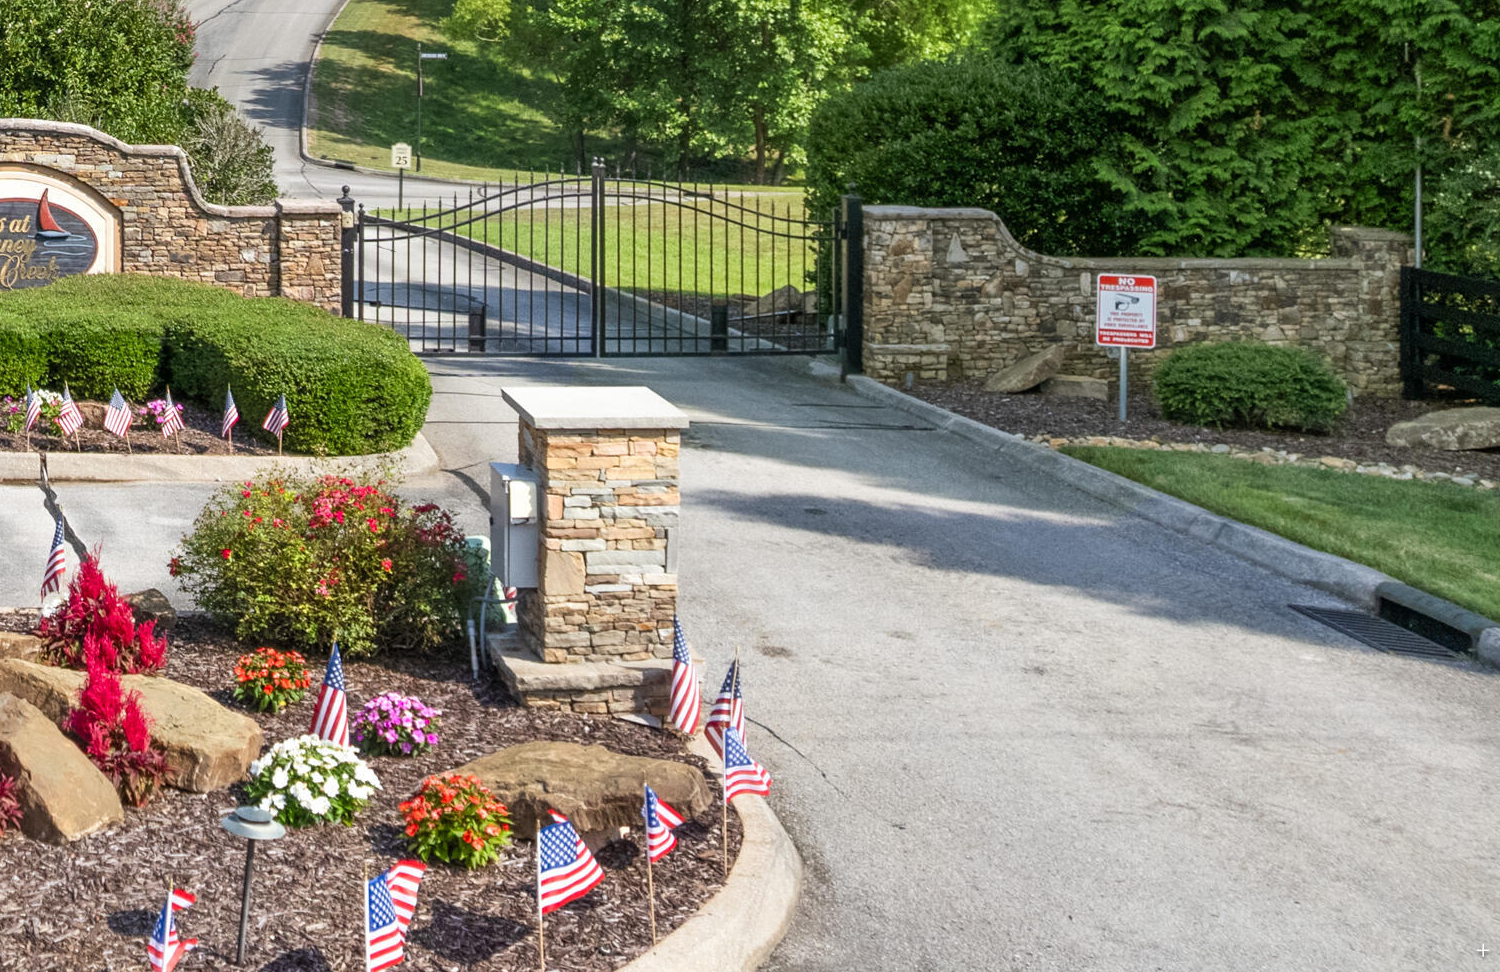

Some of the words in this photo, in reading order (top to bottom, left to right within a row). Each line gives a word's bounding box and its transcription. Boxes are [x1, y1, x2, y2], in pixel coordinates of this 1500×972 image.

[396, 156, 408, 165] 25
[9, 215, 32, 233] at
[1118, 277, 1136, 286] NO
[1100, 284, 1153, 293] TRESPASSING
